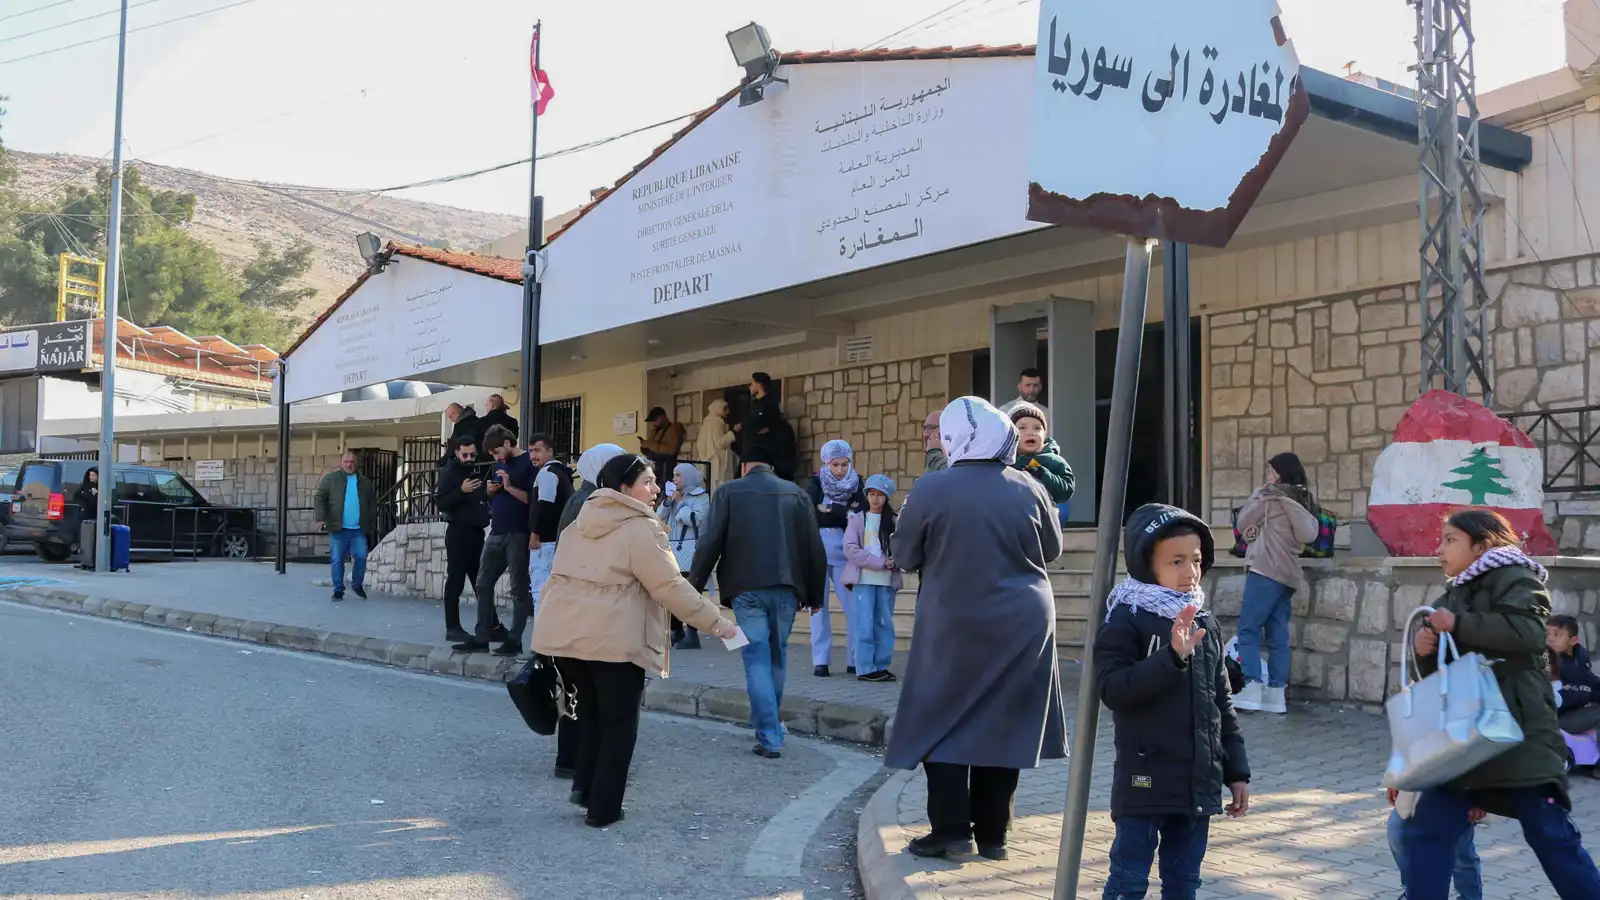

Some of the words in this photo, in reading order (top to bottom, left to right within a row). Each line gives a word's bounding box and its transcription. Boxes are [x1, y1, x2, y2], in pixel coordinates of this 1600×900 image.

[1048, 14, 1133, 101] سوريا
[1142, 43, 1190, 113] الى
[880, 77, 951, 111] الجمهورية
[814, 103, 876, 133] اللبنانية
[871, 112, 913, 136] الداخلية
[916, 106, 944, 123] وزارة
[820, 129, 869, 153] والبلديات
[875, 138, 922, 164] المديرية
[632, 171, 688, 201] REPUBLIQUE
[689, 151, 741, 180] LIBANAISE
[838, 154, 871, 174] العامة
[637, 192, 675, 214] MINISTERE
[675, 188, 686, 201] DE
[850, 176, 876, 198] العام
[916, 186, 950, 207] مركز
[637, 219, 673, 239] DIRECTION
[673, 207, 710, 227] GENERALE
[711, 204, 721, 217] DE
[722, 200, 734, 212] LA
[816, 207, 859, 235] الحدودي
[863, 192, 910, 223] المصنع
[652, 236, 678, 252] SURETE
[678, 224, 716, 244] GENERALE
[839, 217, 923, 259] المغادرة
[630, 268, 651, 282] POSTE
[651, 255, 695, 276] FRONTALIER
[696, 251, 707, 264] DE
[708, 241, 742, 260] MASNAA
[652, 272, 713, 304] DEPART
[40, 350, 85, 366] NAJJAR
[1144, 519, 1161, 534] BE
